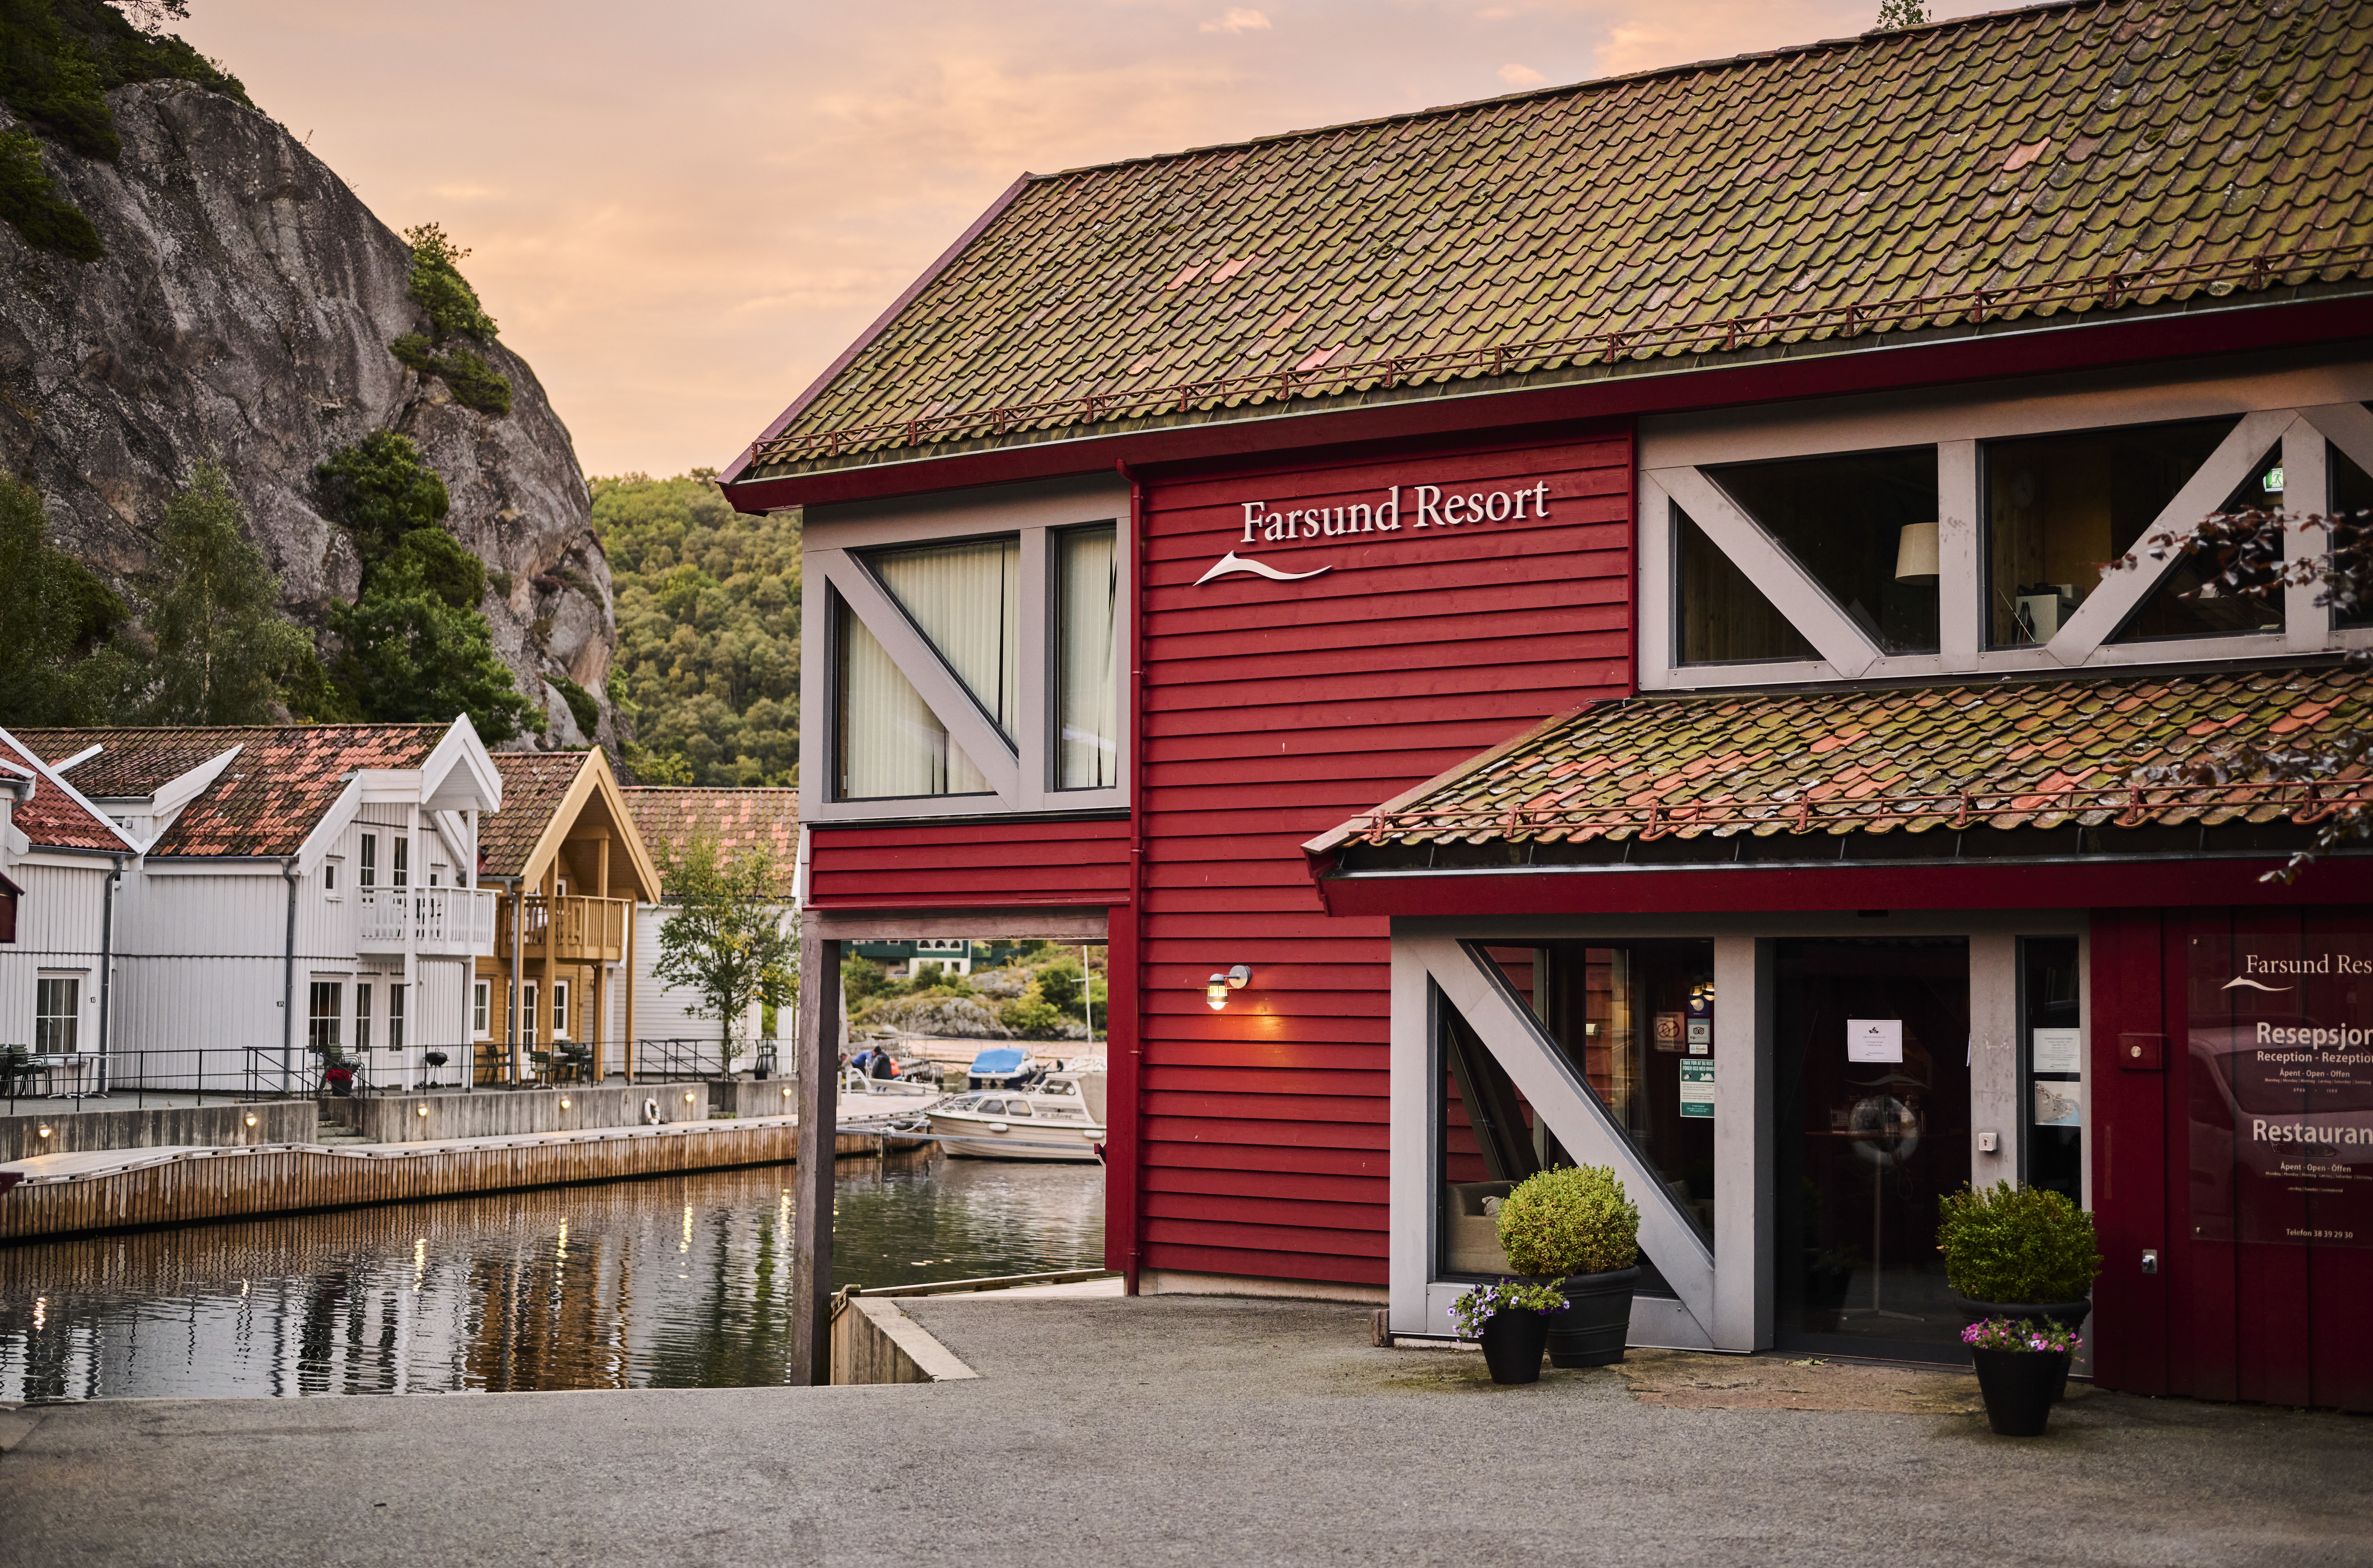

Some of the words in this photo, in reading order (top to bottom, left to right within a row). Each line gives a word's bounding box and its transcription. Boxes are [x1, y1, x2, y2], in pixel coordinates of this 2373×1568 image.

[1241, 485, 1400, 542] Farsund
[1413, 480, 1549, 528] Resort
[2246, 953, 2330, 973] Farsund
[2257, 1051, 2312, 1064] Reception
[2322, 1052, 2373, 1065] Rezeptio
[2280, 1067, 2300, 1077] Åpent
[2306, 1070, 2325, 1078] Open
[2280, 1161, 2301, 1171] Åpent
[2307, 1164, 2326, 1172] Open
[2286, 1228, 2312, 1237] Telefon
